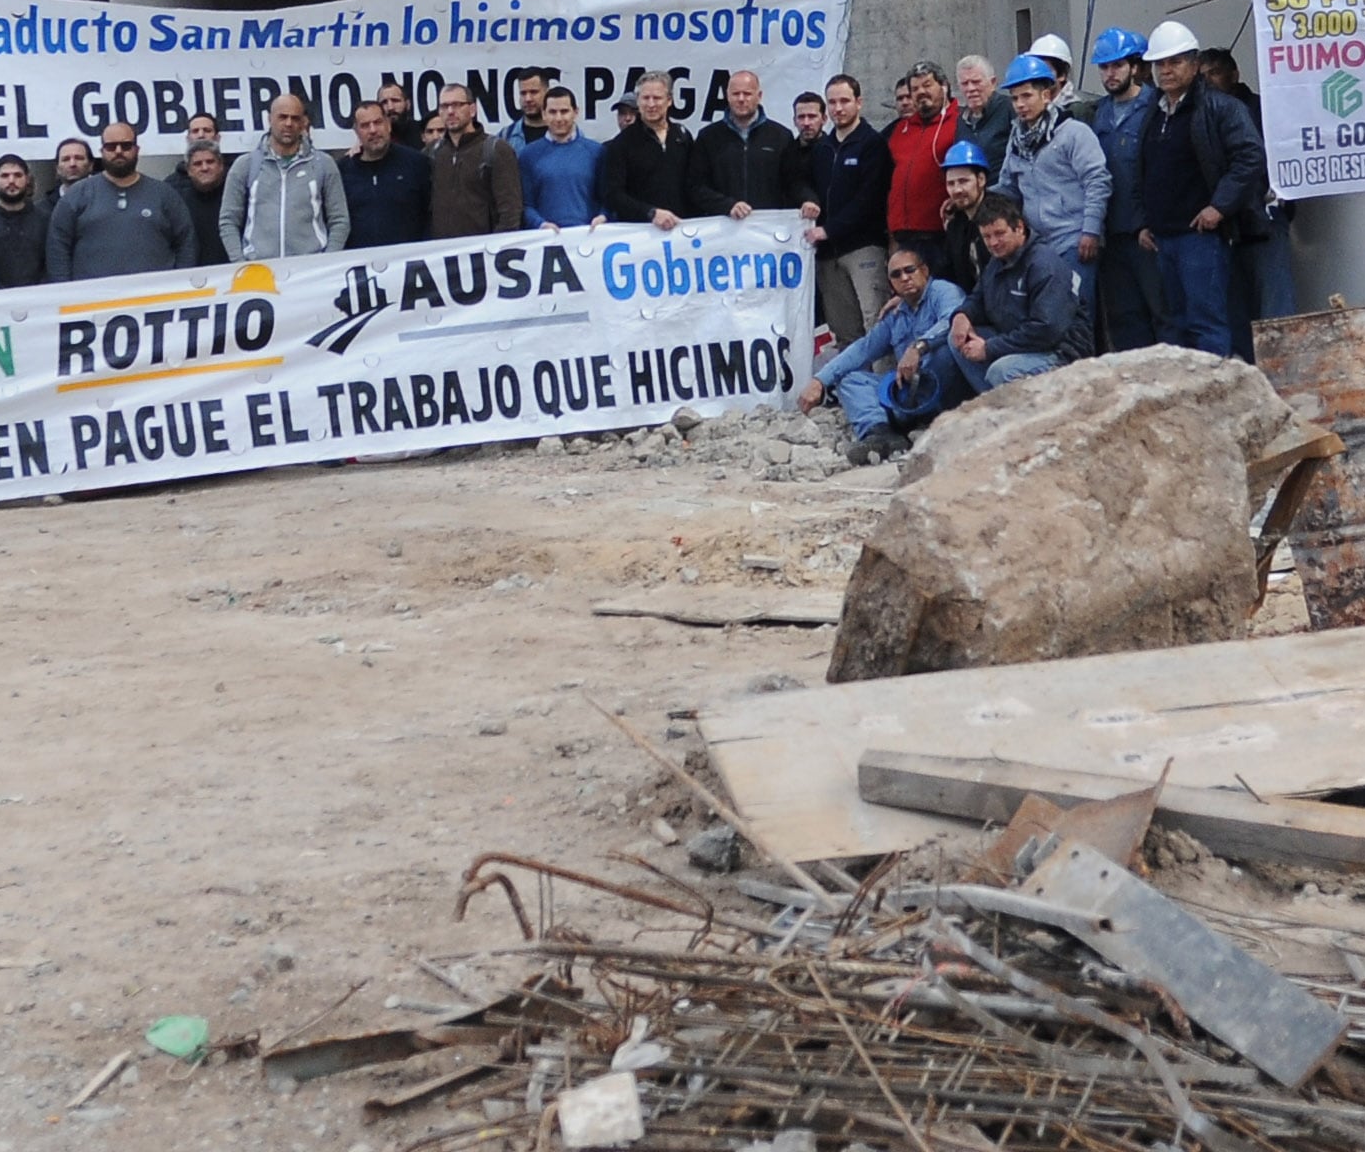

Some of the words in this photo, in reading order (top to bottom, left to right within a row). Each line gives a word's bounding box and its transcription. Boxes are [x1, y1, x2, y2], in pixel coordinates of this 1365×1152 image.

[149, 14, 231, 53] San
[239, 10, 390, 50] Martín
[402, 4, 437, 46] lo
[450, 0, 622, 44] hicimos
[1268, 14, 1285, 41] Y
[1292, 10, 1357, 39] 3.000
[72, 72, 363, 138] GOBIERNO
[1301, 126, 1325, 151] EL
[1278, 159, 1302, 188] NO
[1306, 157, 1325, 185] SE
[399, 245, 585, 312] AUSA
[601, 238, 804, 301] Gobierno
[56, 297, 275, 377] ROTTIO
[71, 398, 229, 470] PAGUE
[245, 390, 310, 448] EL
[318, 363, 522, 438] TRABAJO
[534, 353, 614, 418] QUE
[627, 336, 794, 405] HICIMOS
